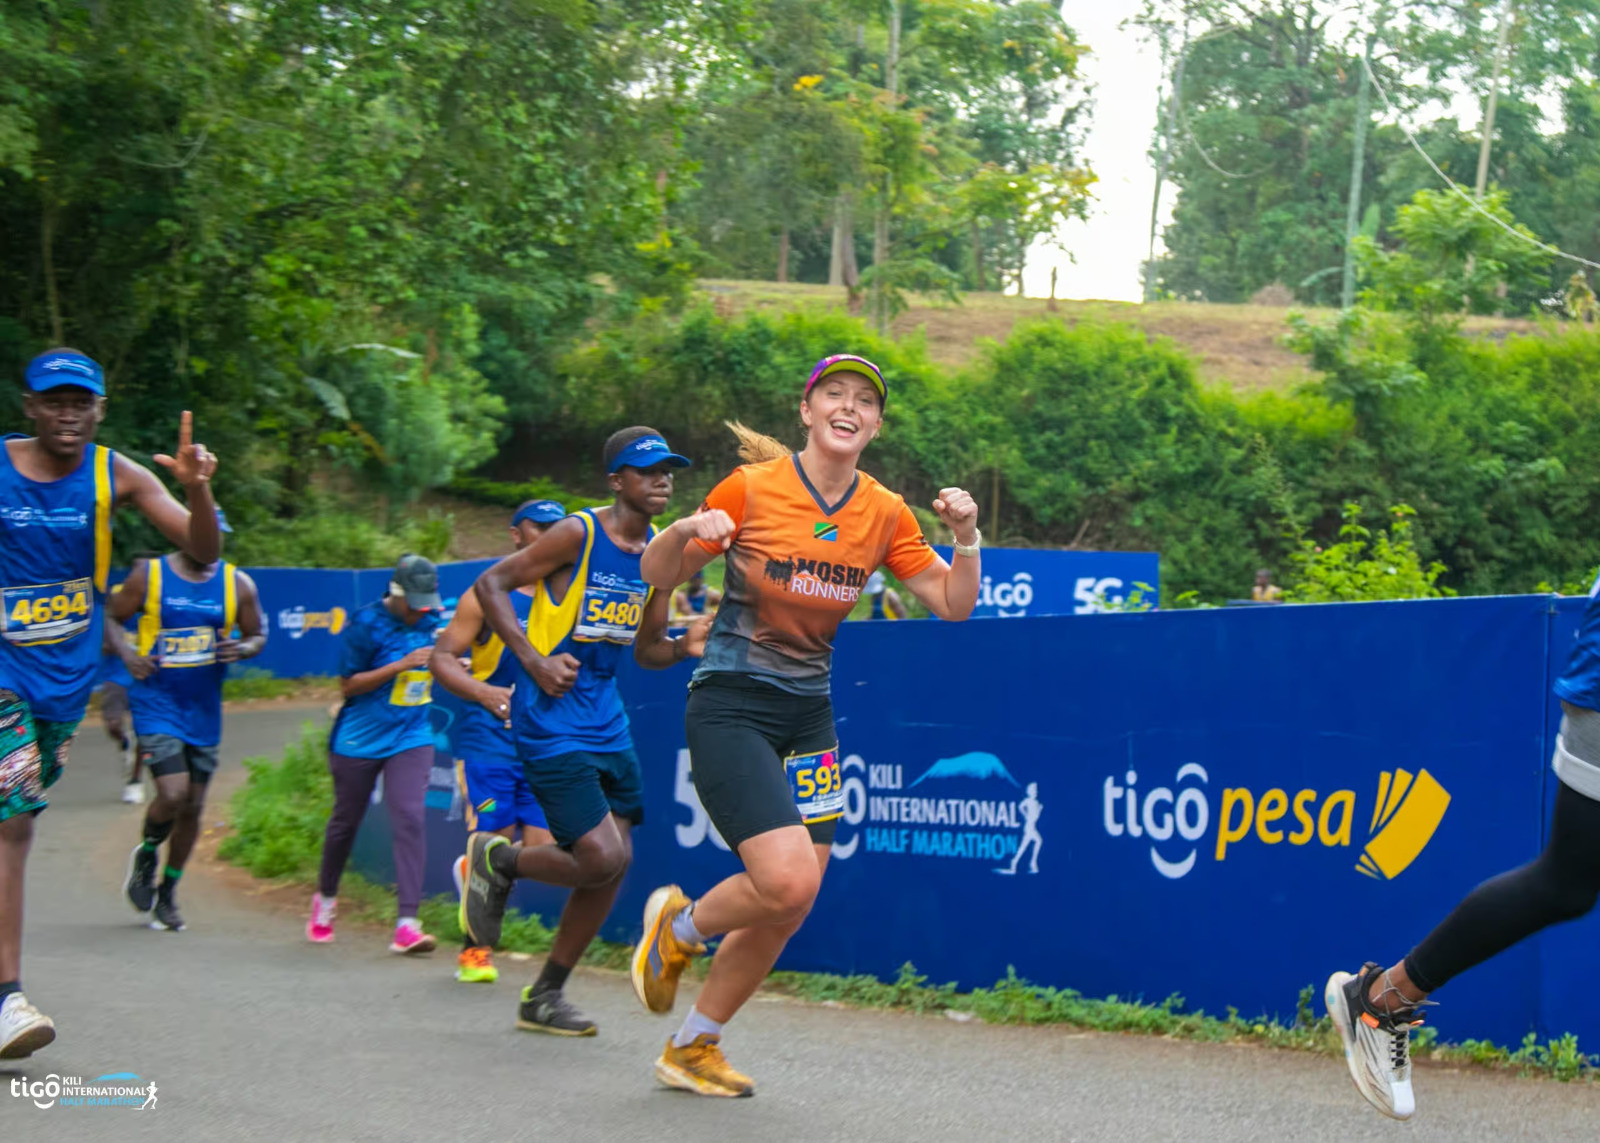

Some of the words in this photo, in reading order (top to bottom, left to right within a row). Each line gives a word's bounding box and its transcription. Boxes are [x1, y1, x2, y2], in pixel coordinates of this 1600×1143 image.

[791, 577, 860, 602] RUNNERS
[11, 591, 88, 625] 4694
[586, 598, 641, 626] 5480
[869, 764, 902, 790] KILI
[869, 796, 1021, 828] INTERNATIONAL
[1215, 787, 1356, 861] pesa
[865, 827, 910, 853] HALF
[911, 829, 1018, 860] MARATHON
